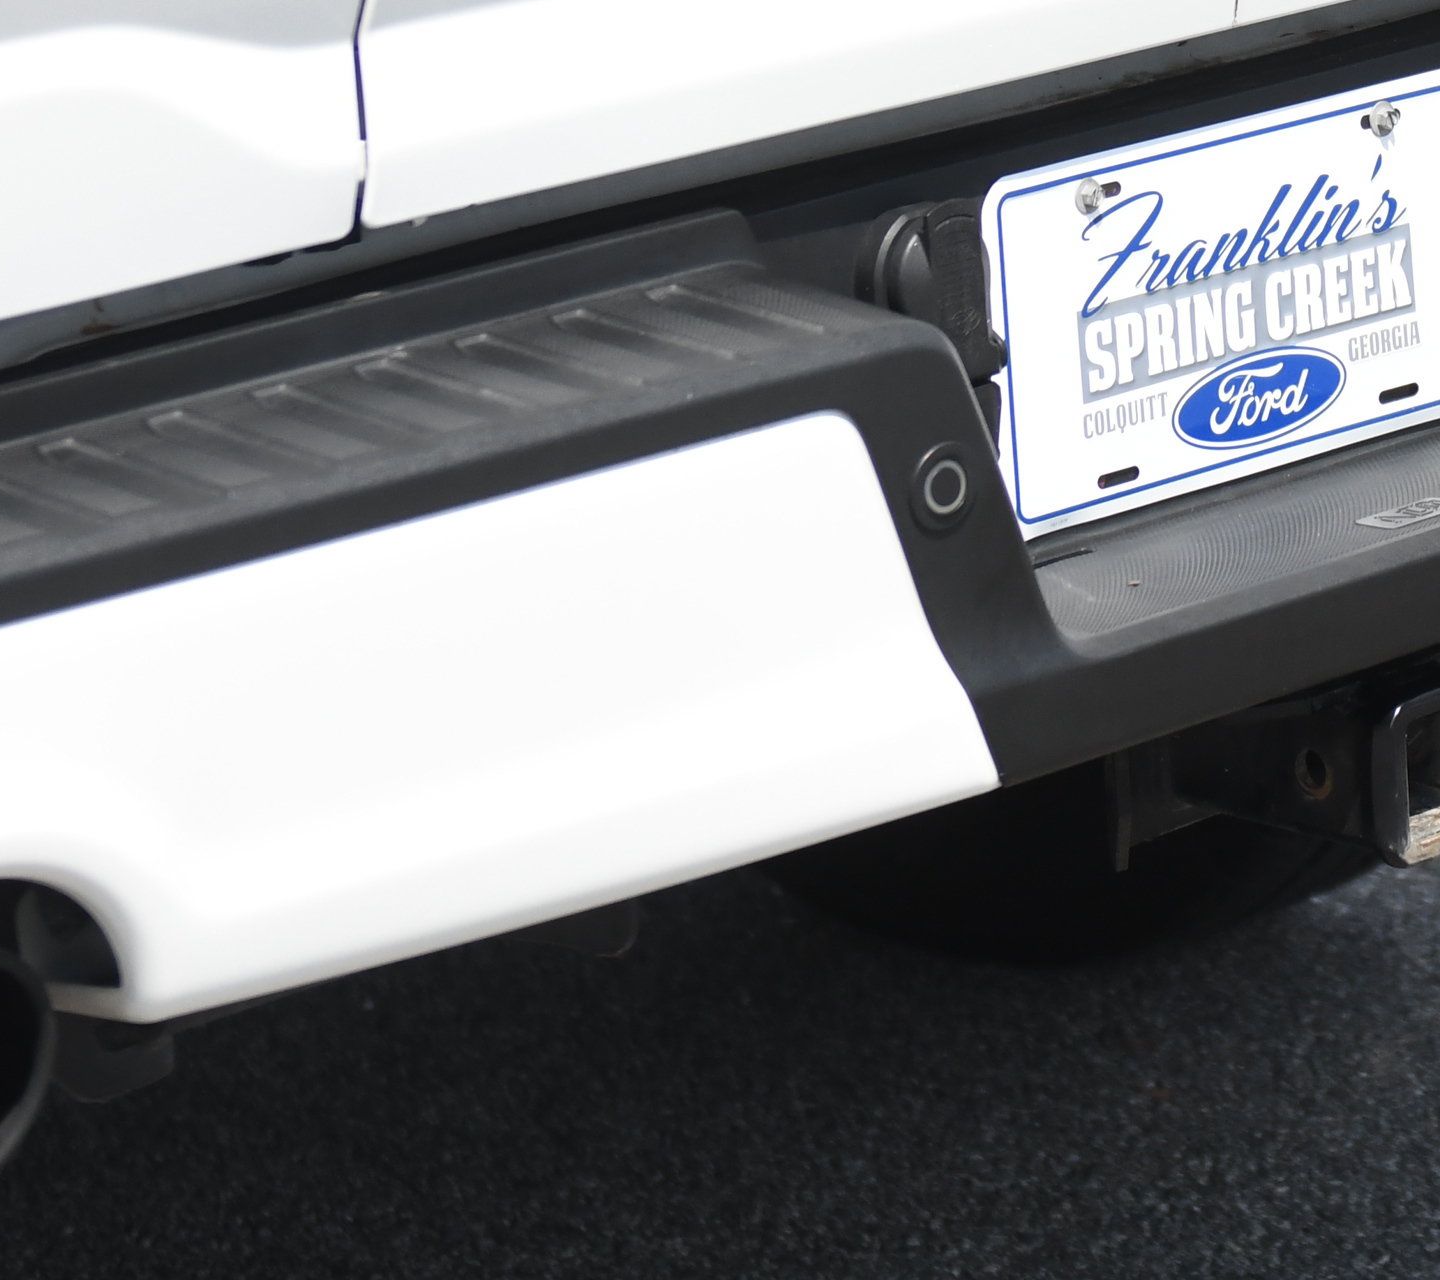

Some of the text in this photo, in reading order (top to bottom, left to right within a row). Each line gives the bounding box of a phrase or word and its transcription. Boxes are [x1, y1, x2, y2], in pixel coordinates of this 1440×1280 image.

[1081, 153, 1407, 319] Franklin's
[1085, 237, 1413, 395] SPRING CREEK
[1347, 321, 1422, 363] GEORGIA
[1082, 391, 1169, 440] COLQUITT
[1209, 360, 1310, 436] Ford
